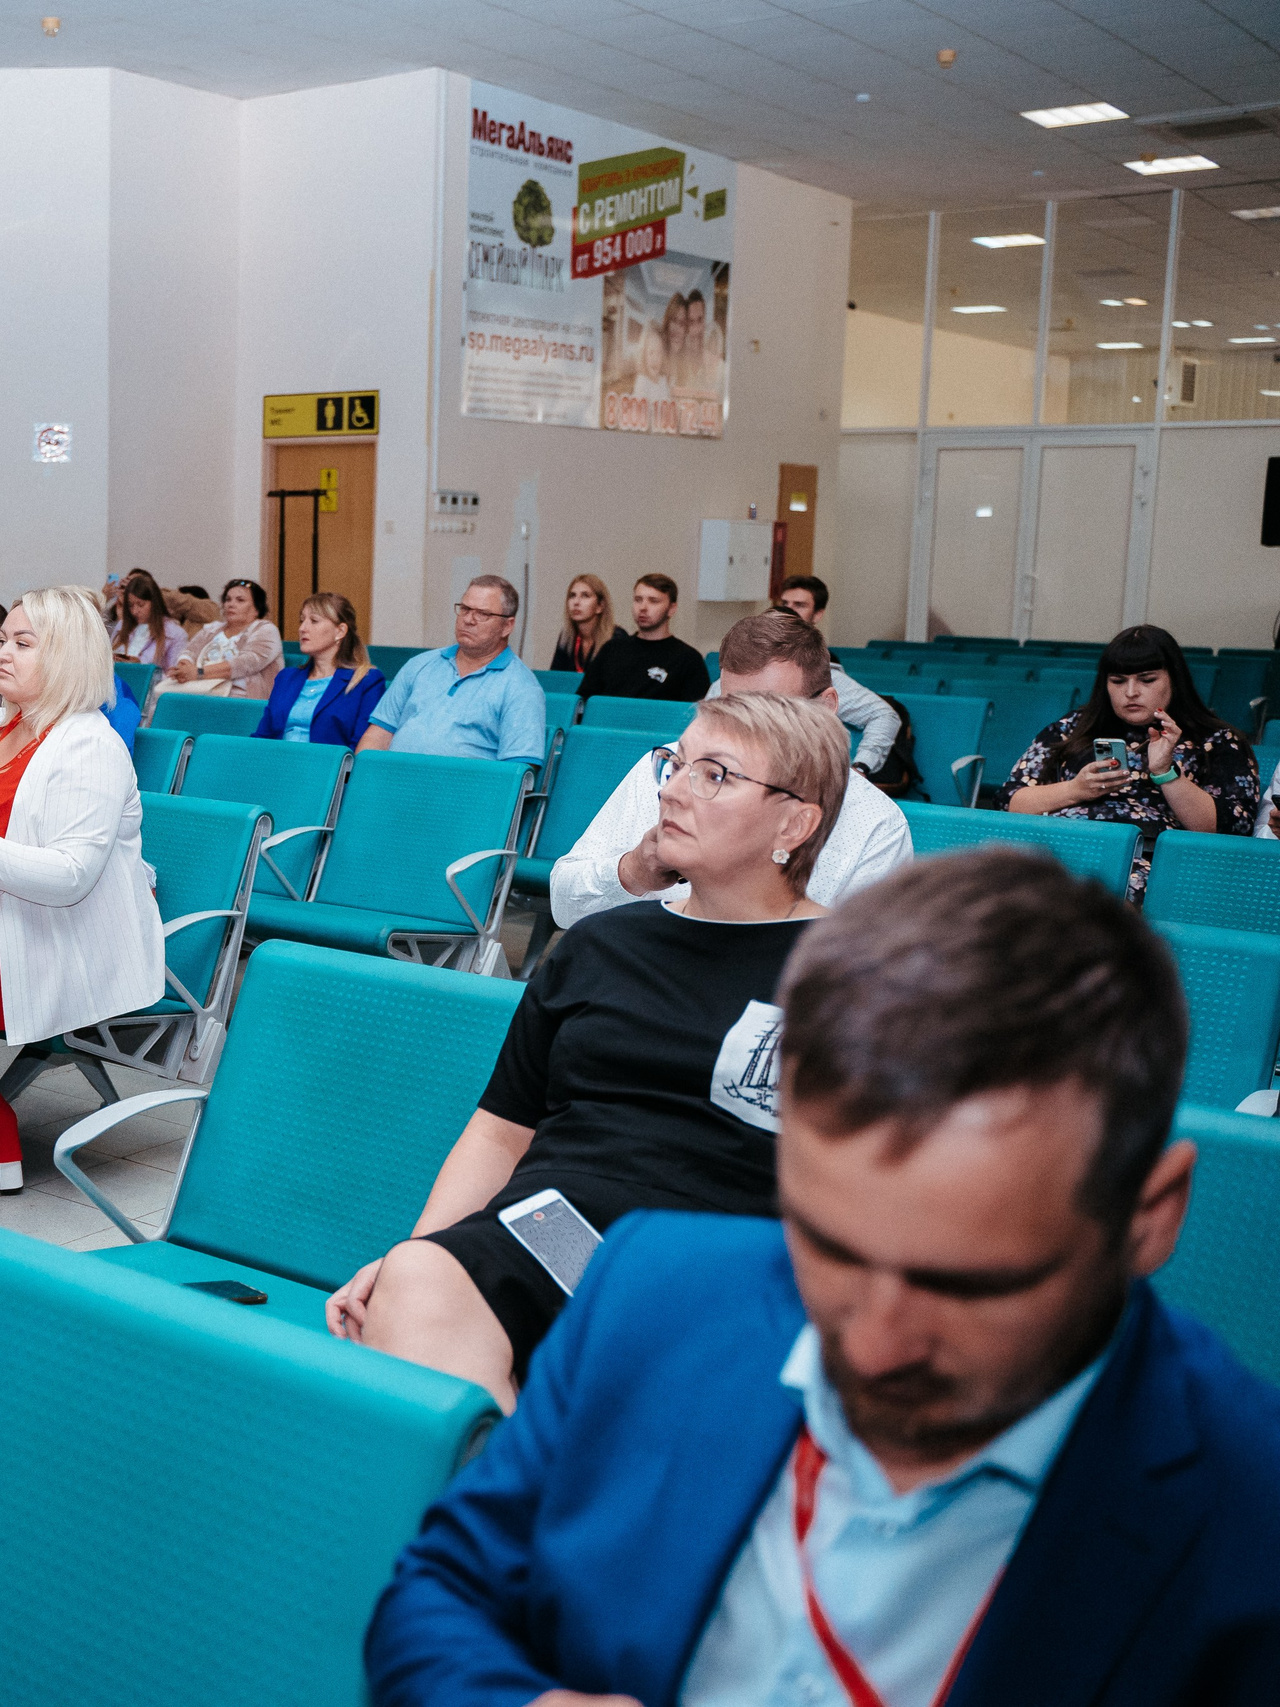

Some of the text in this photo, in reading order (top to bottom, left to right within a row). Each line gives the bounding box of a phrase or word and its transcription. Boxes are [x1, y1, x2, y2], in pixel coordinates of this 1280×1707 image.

[472, 107, 573, 165] МегаАльянс
[579, 176, 681, 236] С РЕМОНТОМ
[593, 234, 622, 269] 954
[625, 227, 653, 260] 000
[467, 331, 595, 364] sp.megaalyans.ru
